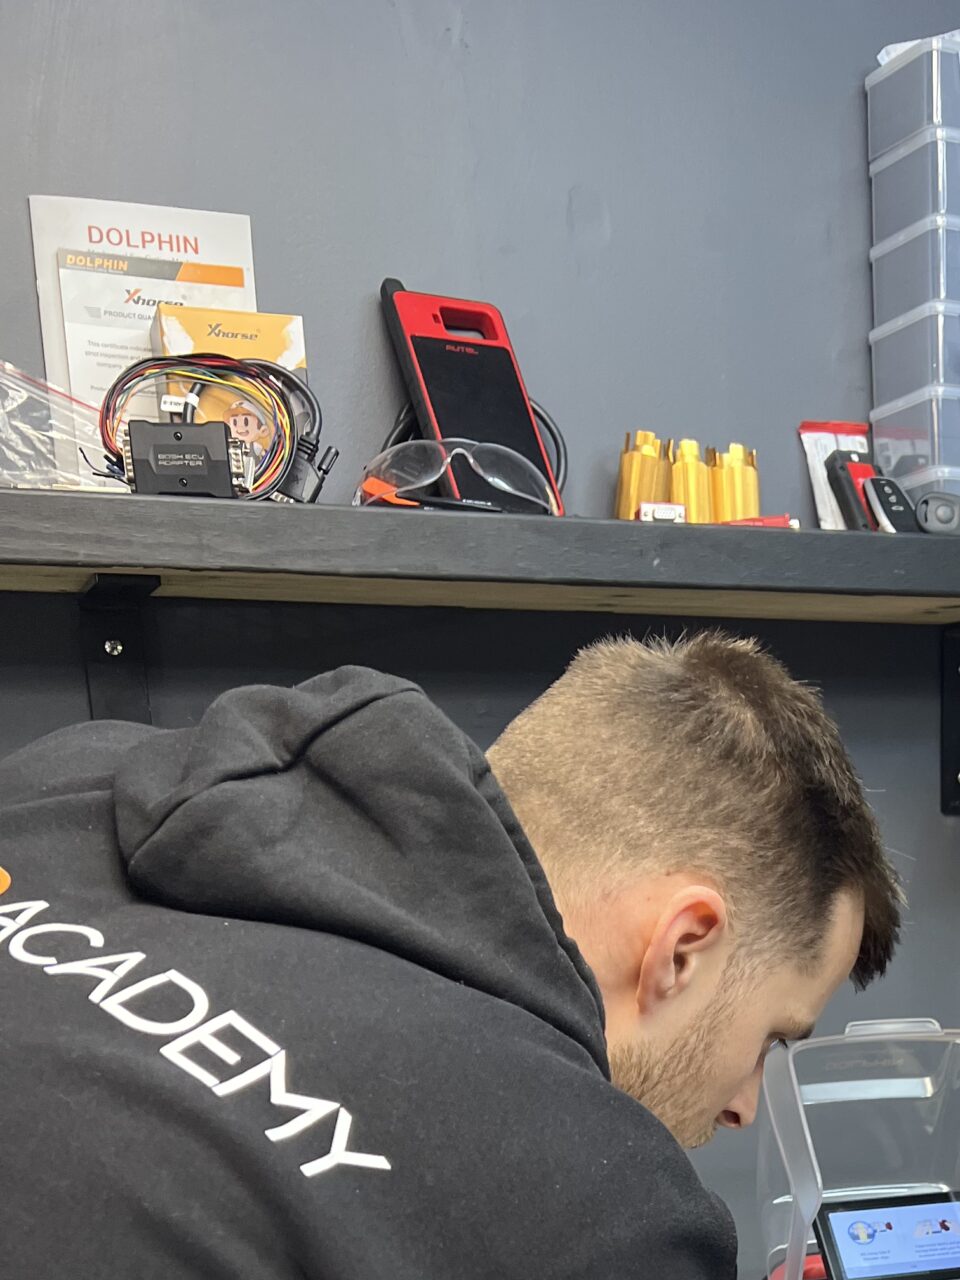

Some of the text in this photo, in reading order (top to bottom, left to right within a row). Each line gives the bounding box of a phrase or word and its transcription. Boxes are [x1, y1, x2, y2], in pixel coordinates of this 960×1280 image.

[87, 225, 199, 255] DOLPHIN
[66, 255, 128, 271] DOLPHIN
[103, 310, 154, 321] PRODUCT QUA
[207, 323, 258, 340] Xhorse
[0, 900, 391, 1177] ACADEMY
